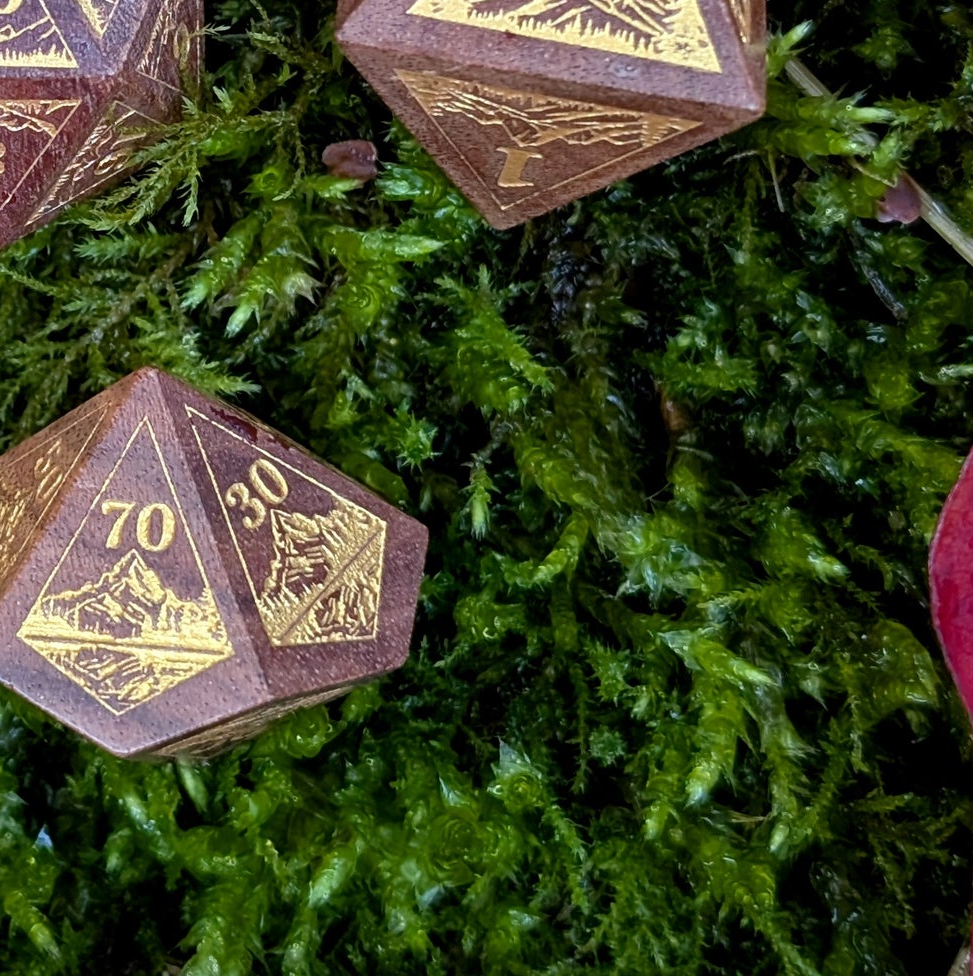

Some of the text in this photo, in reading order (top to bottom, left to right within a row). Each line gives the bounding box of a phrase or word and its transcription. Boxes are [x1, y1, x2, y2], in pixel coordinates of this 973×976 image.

[496, 145, 544, 188] 1
[226, 457, 290, 531] 30
[101, 499, 177, 552] 70
